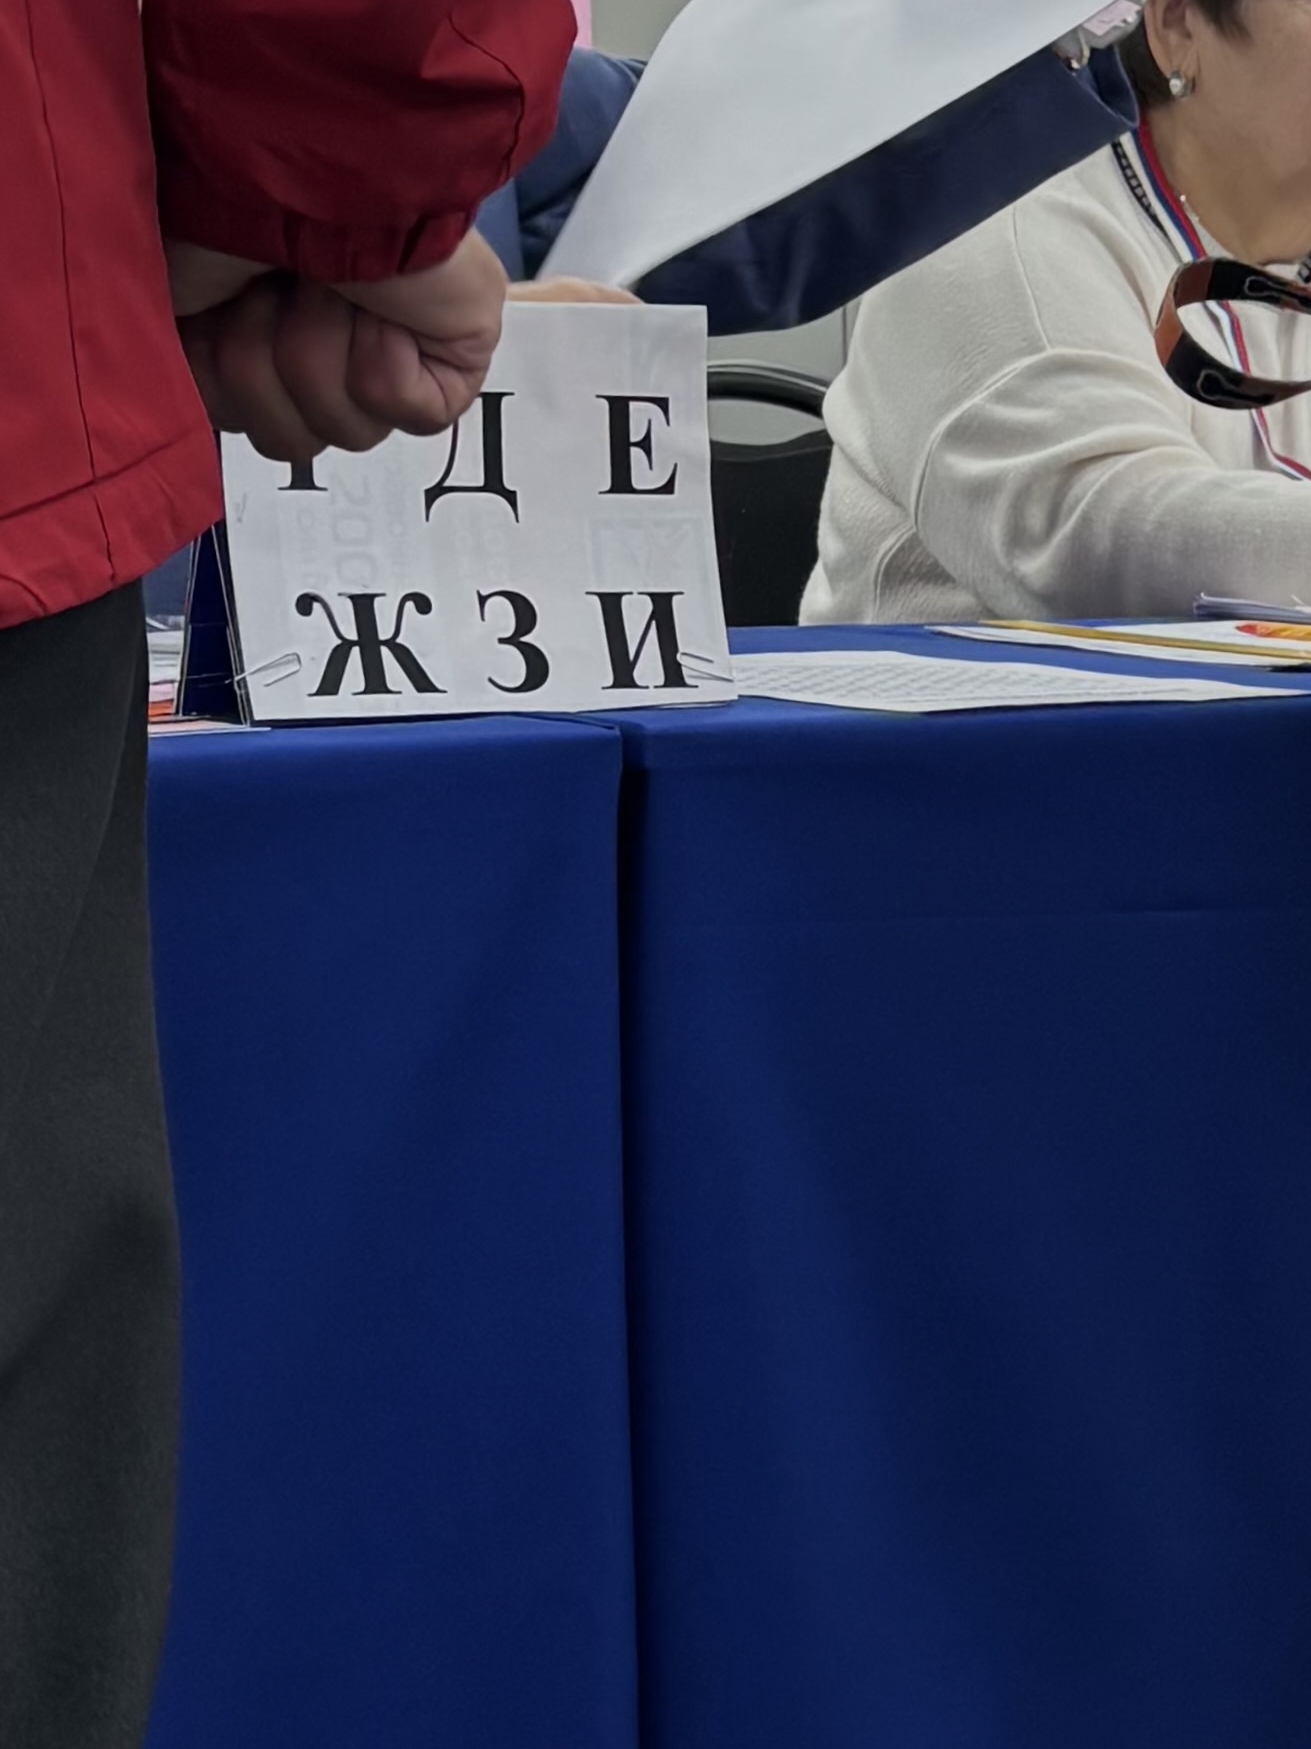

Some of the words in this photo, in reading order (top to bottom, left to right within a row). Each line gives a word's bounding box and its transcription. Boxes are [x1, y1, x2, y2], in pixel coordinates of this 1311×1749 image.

[595, 394, 679, 496] Е
[294, 590, 449, 697] Ж
[476, 589, 550, 694] З
[584, 590, 700, 690] И
